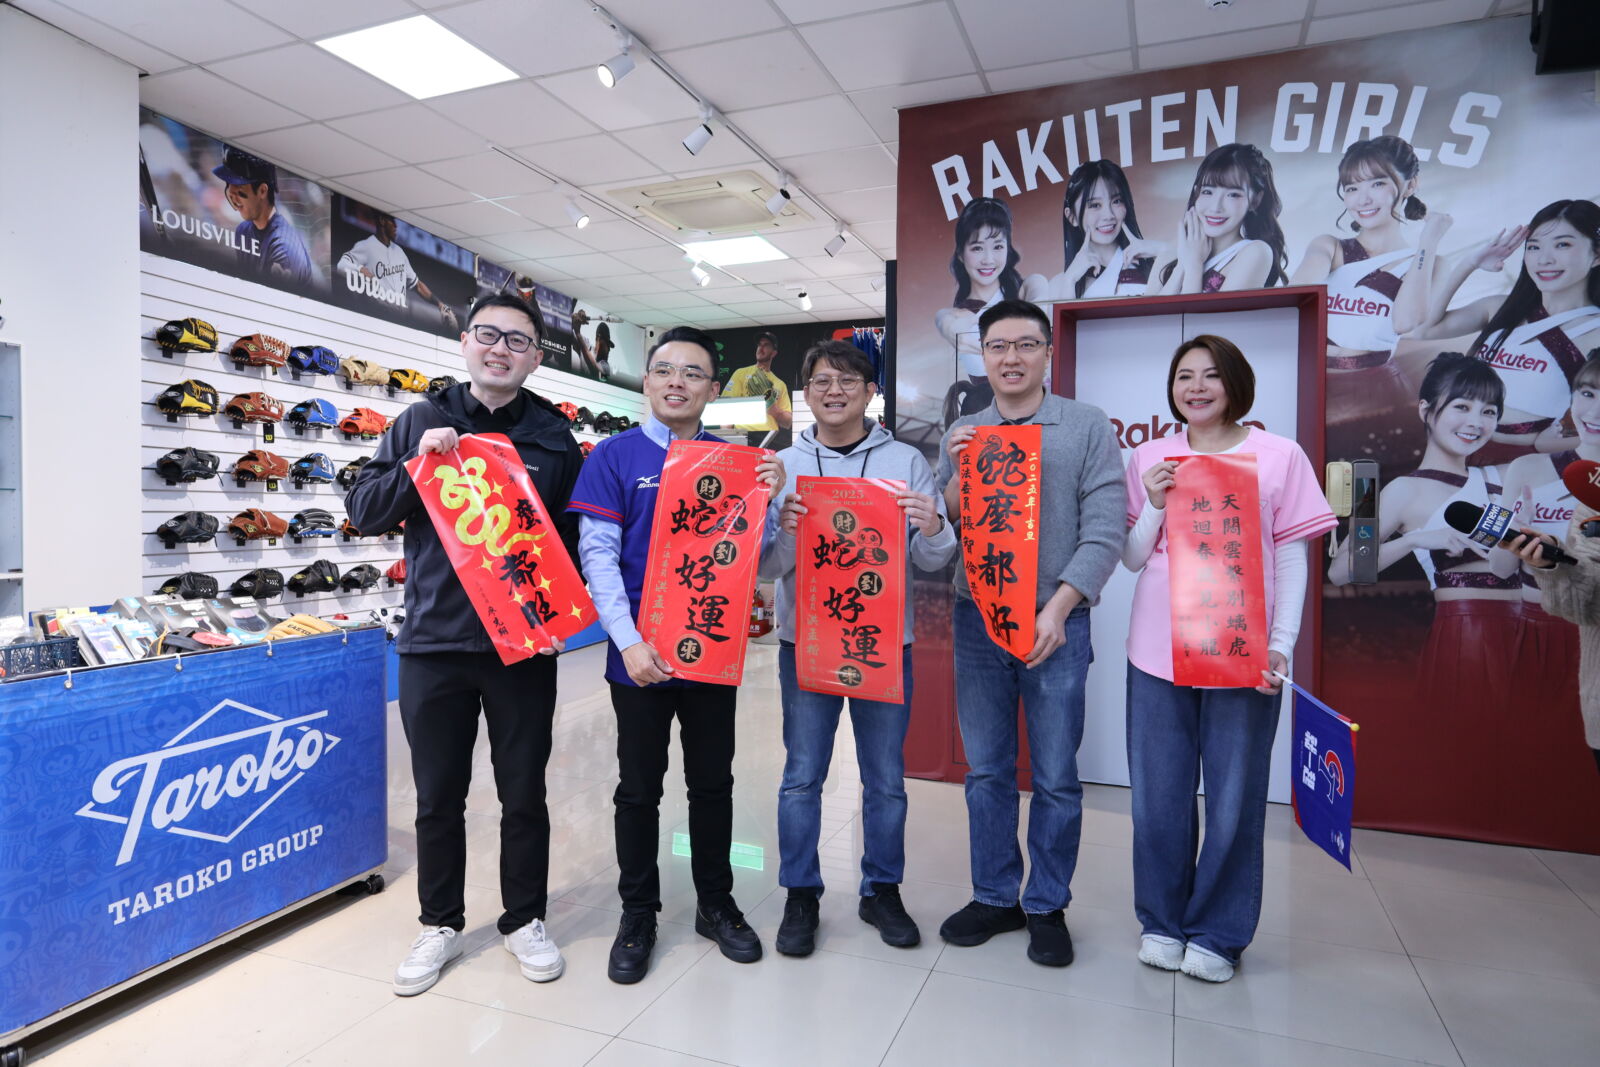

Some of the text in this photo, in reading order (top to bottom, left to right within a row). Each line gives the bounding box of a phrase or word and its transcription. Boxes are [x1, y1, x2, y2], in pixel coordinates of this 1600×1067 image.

[931, 82, 1503, 221] RAKUTEN GIRLS
[152, 204, 261, 257] LOUISVILLE
[346, 268, 409, 308] Wilson
[1327, 293, 1391, 317] akuten
[699, 478, 720, 499] 財
[832, 489, 865, 499] 2025
[714, 543, 735, 562] 到
[860, 574, 880, 593] 到
[92, 710, 329, 866] Taroko
[108, 824, 324, 927] TAROKO GROUP
